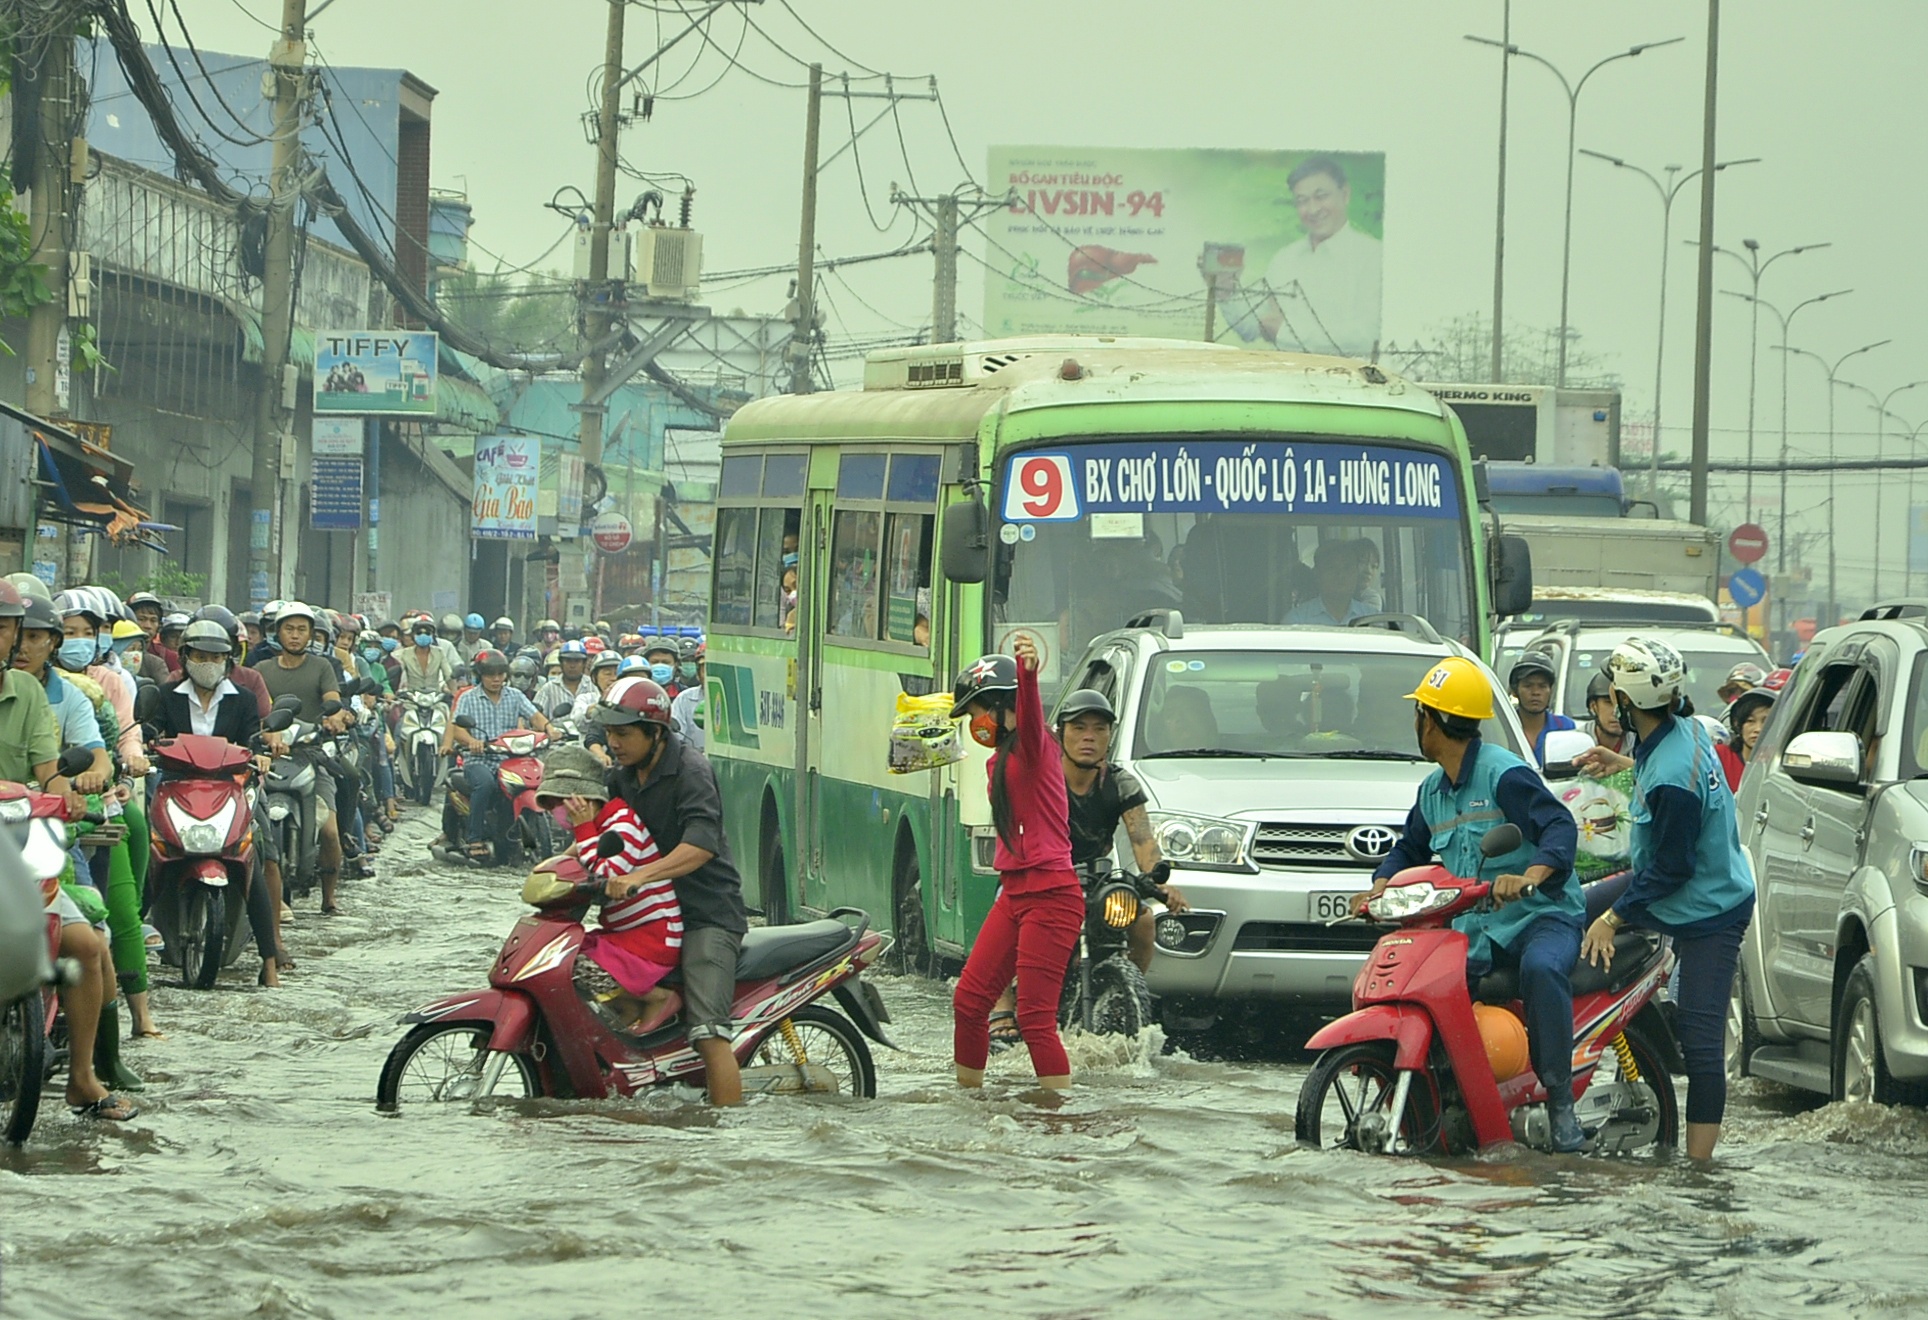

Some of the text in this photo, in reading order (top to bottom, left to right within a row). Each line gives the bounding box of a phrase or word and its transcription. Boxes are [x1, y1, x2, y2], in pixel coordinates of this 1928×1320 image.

[326, 337, 410, 358] TIFFY
[1492, 392, 1532, 402] KING
[1020, 457, 1063, 518] 9
[1085, 458, 1113, 503] BX
[1116, 450, 1157, 512] CHỢ
[1162, 446, 1201, 503] LỚN
[1215, 443, 1267, 510] QUỐC
[1272, 446, 1297, 512] LỘ
[1394, 461, 1442, 508] LONG
[473, 483, 533, 525] Gia Bảo
[1317, 894, 1352, 918] 66
